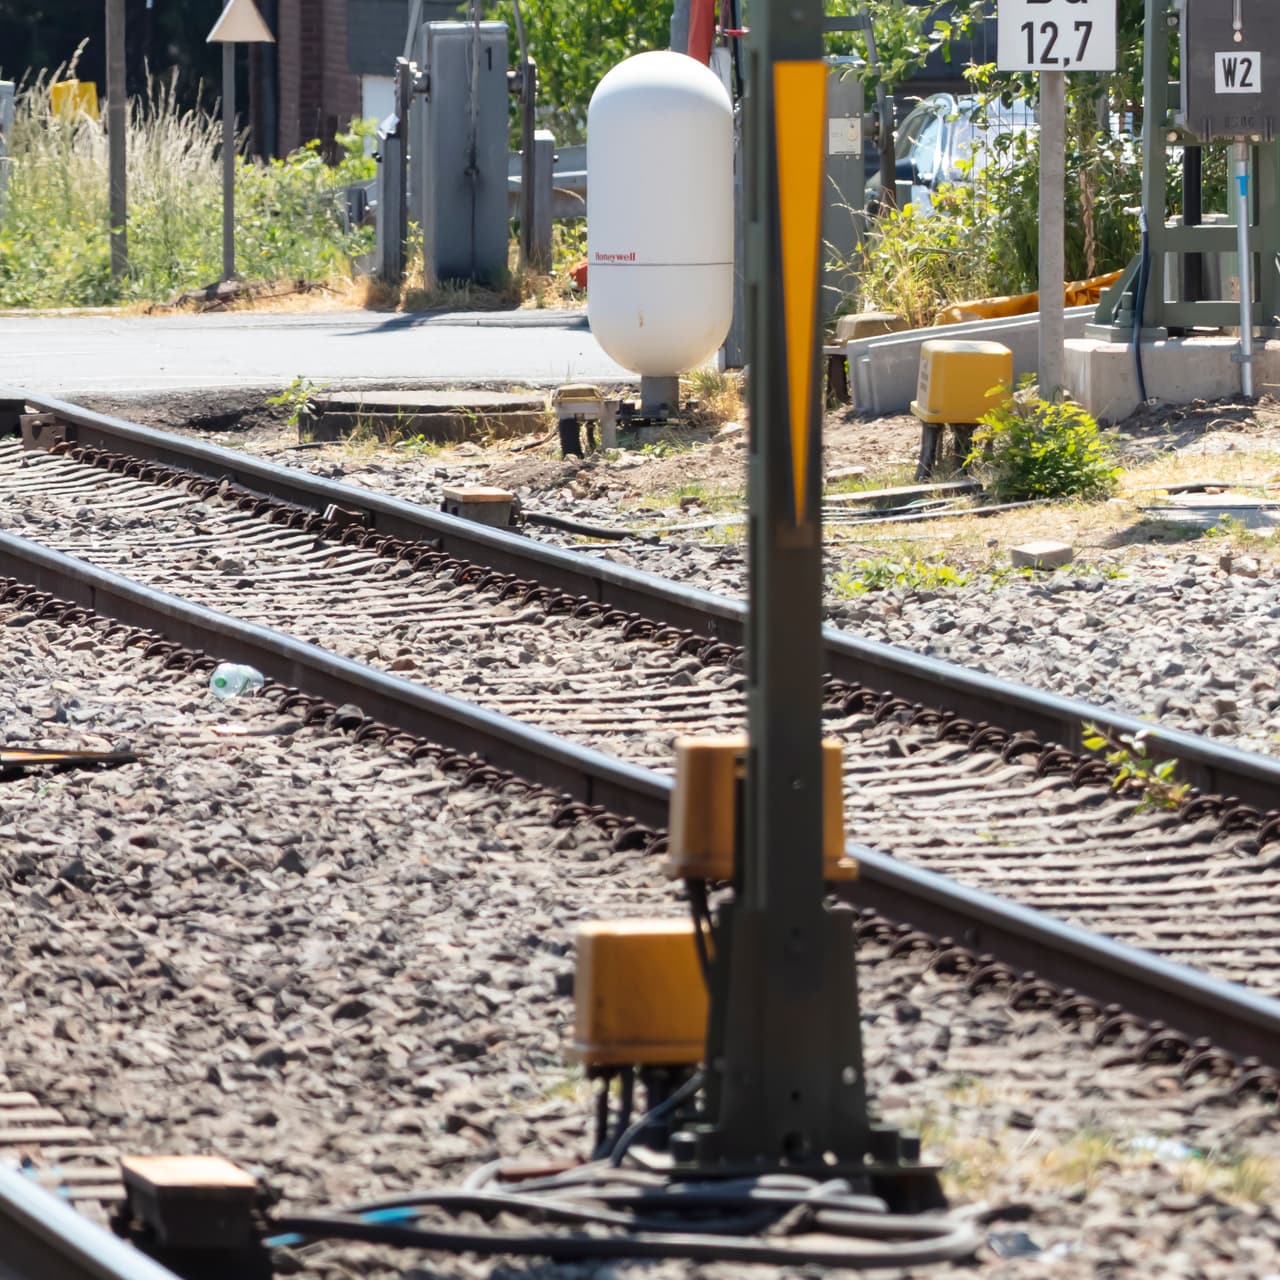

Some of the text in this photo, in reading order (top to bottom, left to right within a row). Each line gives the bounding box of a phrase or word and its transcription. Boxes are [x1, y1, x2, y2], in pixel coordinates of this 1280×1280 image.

[485, 46, 492, 71] 1
[1021, 21, 1093, 68] 12,7
[1222, 57, 1253, 88] W2
